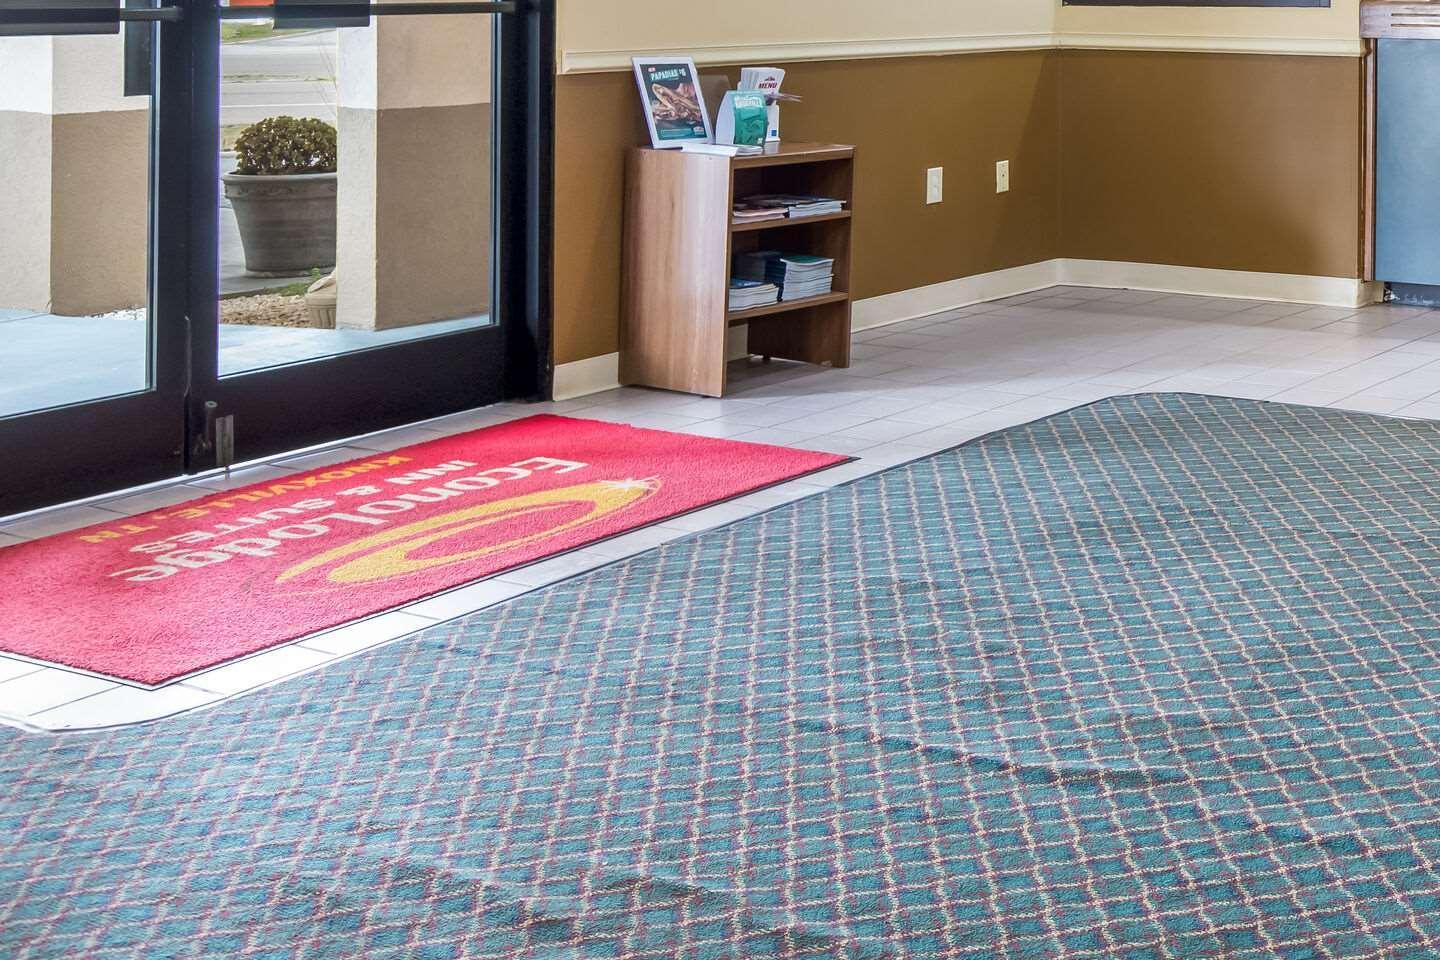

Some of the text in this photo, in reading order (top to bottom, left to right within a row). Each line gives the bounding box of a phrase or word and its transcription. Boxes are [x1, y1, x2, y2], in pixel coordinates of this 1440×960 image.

[758, 81, 778, 89] MENU
[79, 523, 160, 544] TN
[106, 455, 590, 582] EconoLodge
[127, 459, 478, 554] INN & SUITES
